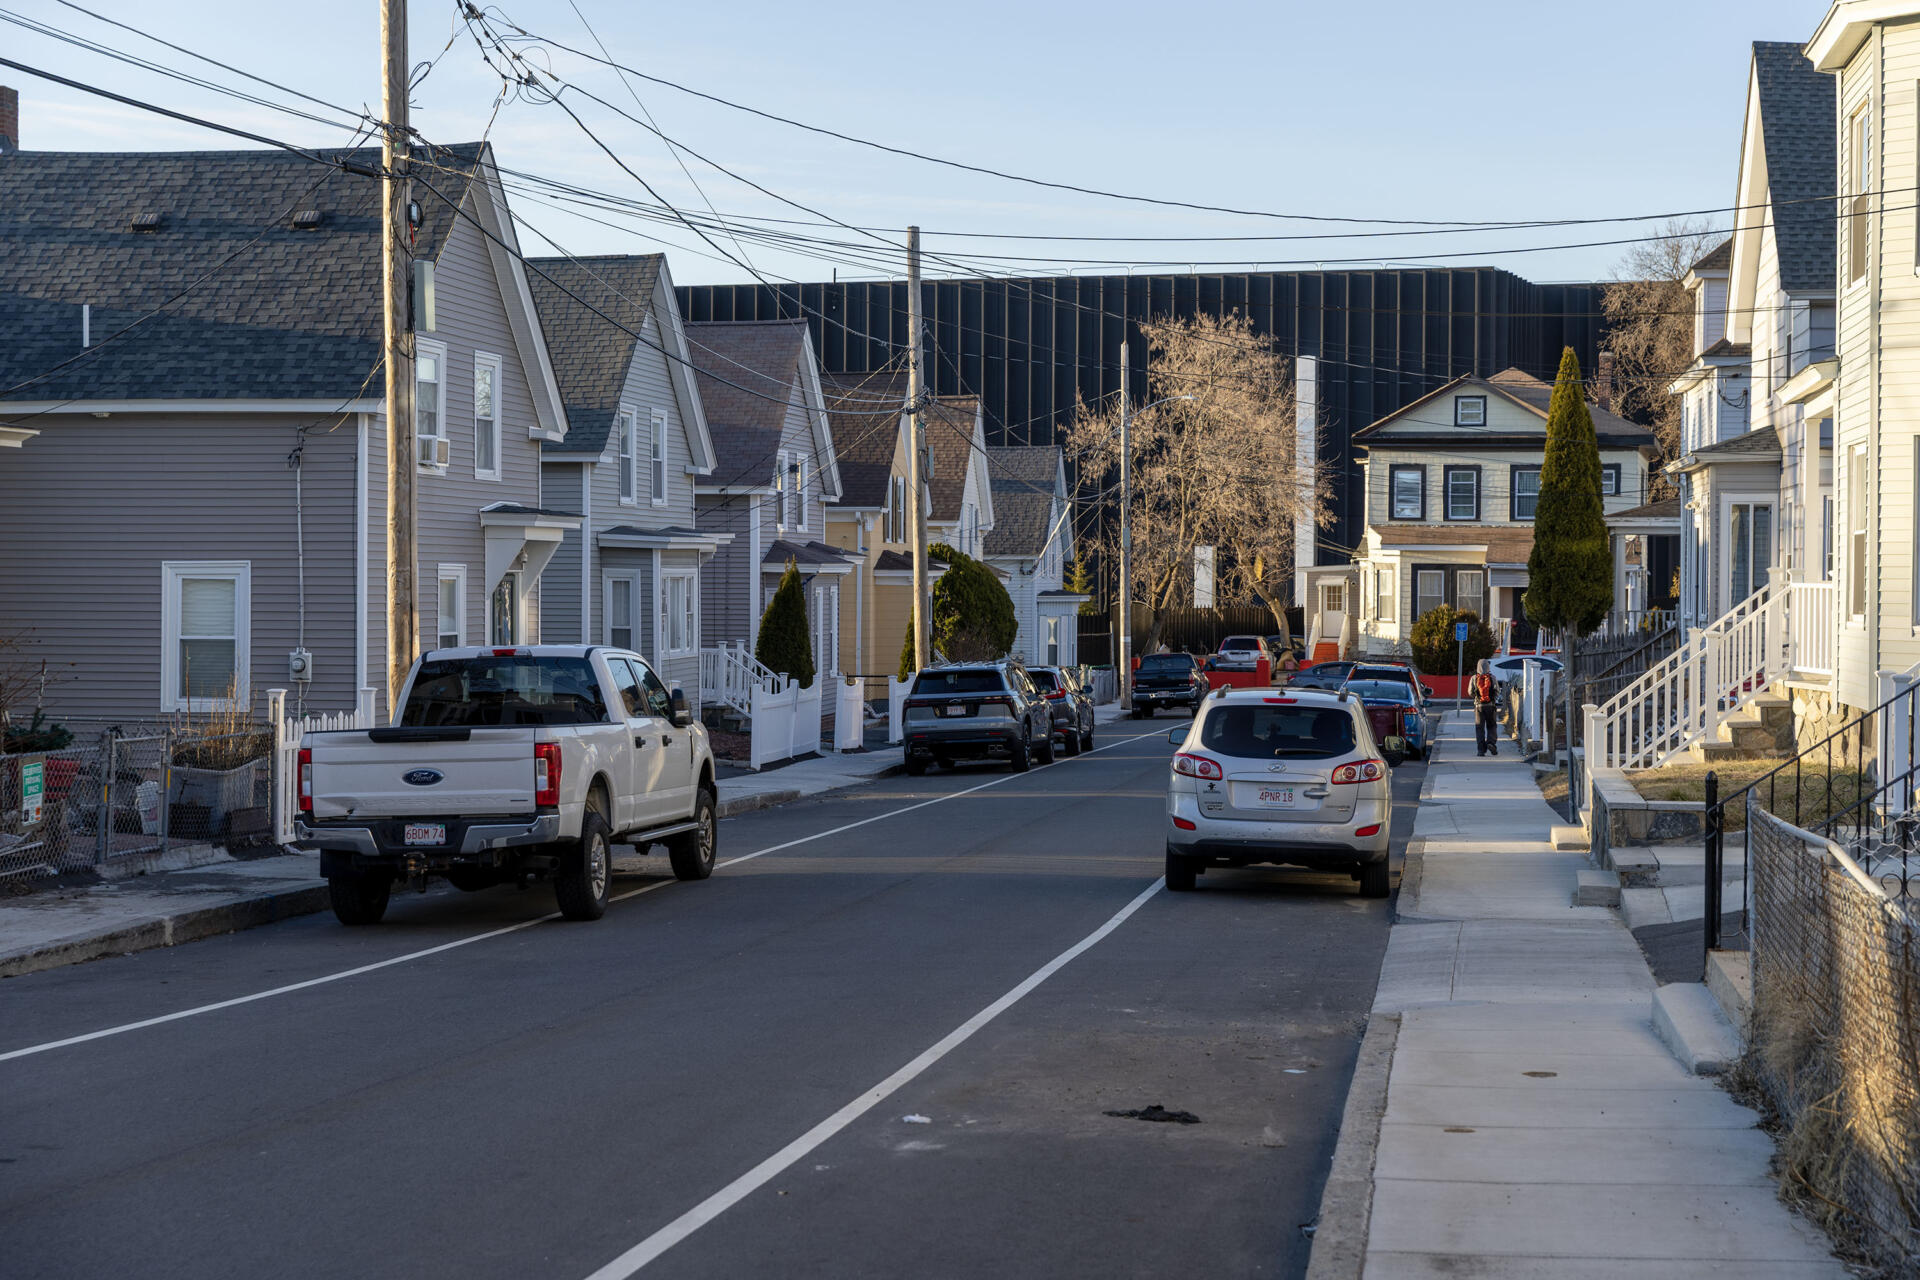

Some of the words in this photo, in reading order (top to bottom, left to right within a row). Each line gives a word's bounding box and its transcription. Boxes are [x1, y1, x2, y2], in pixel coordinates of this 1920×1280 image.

[411, 772, 434, 783] Ford
[1259, 791, 1280, 802] 4PNR
[1282, 792, 1293, 802] 18
[406, 828, 429, 840] 6BDM
[432, 828, 444, 839] 74
